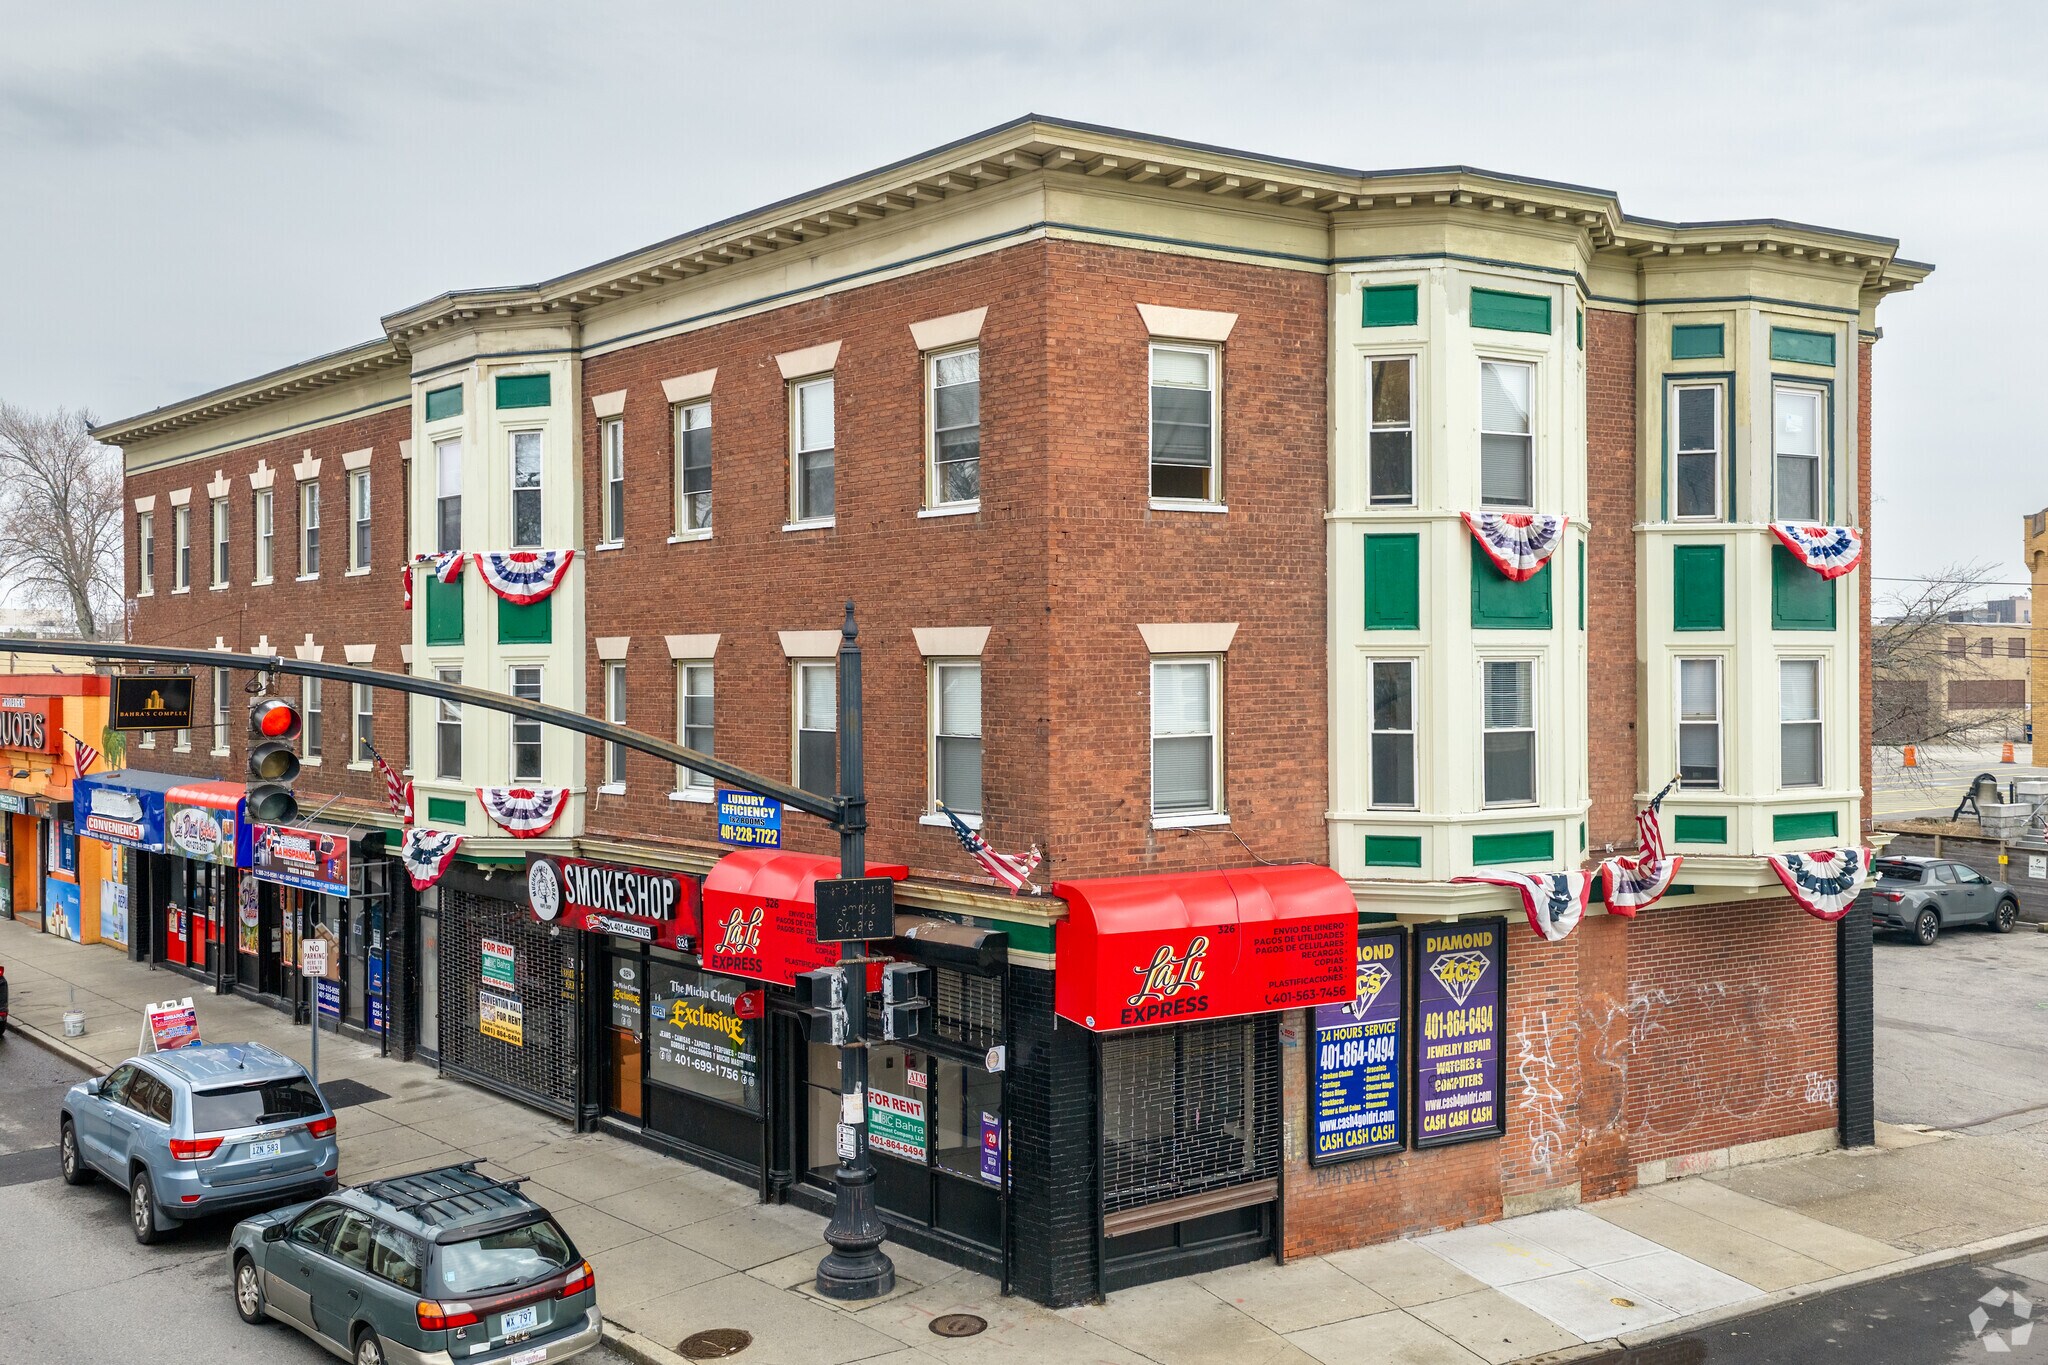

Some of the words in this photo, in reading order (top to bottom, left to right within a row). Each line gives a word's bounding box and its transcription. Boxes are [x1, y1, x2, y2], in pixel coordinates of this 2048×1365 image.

[0, 711, 45, 750] UORS
[727, 793, 766, 806] LUXURY
[721, 803, 776, 818] EFFICIENCY
[88, 817, 138, 838] CONVENIENCE
[740, 817, 765, 826] ROOMS
[720, 824, 778, 845] 401-228-7722
[283, 848, 316, 862] HISPANIOLA
[564, 864, 674, 921] SMOKESHOP
[765, 898, 779, 909] 326
[613, 922, 650, 938] 401-445-4705
[1217, 924, 1236, 935] 326
[1273, 926, 1299, 935] ENVIO
[1301, 925, 1312, 933] DE
[1313, 922, 1344, 931] DINERO
[677, 936, 689, 949] 324
[1254, 937, 1283, 946] PAGOS
[1284, 935, 1296, 943] DE
[1298, 931, 1345, 942] UTILIDADES
[1426, 931, 1493, 953] DIAMOND
[304, 952, 325, 960] PARKING
[309, 944, 320, 952] NO
[483, 941, 496, 953] FOR
[496, 945, 513, 957] RENT
[1255, 946, 1284, 955] PAGOS
[1286, 944, 1297, 952] DE
[1299, 940, 1344, 951] CELULARES
[1302, 948, 1344, 959] RECARGAS
[712, 954, 763, 974] EXPRESS
[1314, 957, 1344, 967] COPIAS
[1328, 965, 1344, 973] FAX
[669, 979, 685, 994] The
[685, 983, 710, 1000] Micha
[1269, 973, 1344, 989] PLASTIFICACIONES
[481, 992, 510, 1010] CONVENTION
[1273, 985, 1347, 1003] 401-563-7456
[652, 1005, 666, 1018] OPEN
[1121, 995, 1209, 1025] EXPRESS
[496, 1011, 507, 1020] FOR
[508, 1014, 521, 1027] RENT
[1424, 1005, 1493, 1040] 401-864-6494
[482, 1026, 496, 1036] (401)
[1321, 1031, 1331, 1042] 24
[1333, 1026, 1362, 1041] HOURS
[1364, 1021, 1396, 1037] SERVICE
[659, 1029, 672, 1040] JEANS
[693, 1039, 711, 1051] ZAPATOS
[713, 1045, 734, 1057] PERFUMES
[737, 1051, 756, 1064] CORREAS
[1320, 1036, 1395, 1070] 401-864-6494
[1426, 1042, 1463, 1059] JEWELRY
[1463, 1038, 1491, 1054] REPAIR
[674, 1053, 739, 1081] 401-699-1756
[716, 1053, 731, 1064] MUCHO
[1436, 1057, 1475, 1075] WATCHES
[1476, 1058, 1483, 1069] &
[909, 1071, 927, 1084] ATM
[1435, 1073, 1484, 1092] COMPUTERS
[868, 1091, 891, 1108] FOR
[891, 1097, 921, 1116] RENT
[1424, 1090, 1492, 1112] www.cash4goldri.com
[895, 1118, 924, 1135] Bahra
[1320, 1110, 1395, 1133] www.cash4goldri.com
[1424, 1114, 1447, 1132] CASH
[1448, 1109, 1469, 1128] CASH
[1471, 1106, 1493, 1124] CASH
[1320, 1132, 1344, 1151] CASH
[1345, 1128, 1369, 1147] CASH
[1371, 1123, 1395, 1142] CASH
[266, 1143, 279, 1152] 583
[869, 1135, 924, 1157] 401-864-6494
[505, 1317, 515, 1328] WX
[519, 1311, 533, 1324] 797
